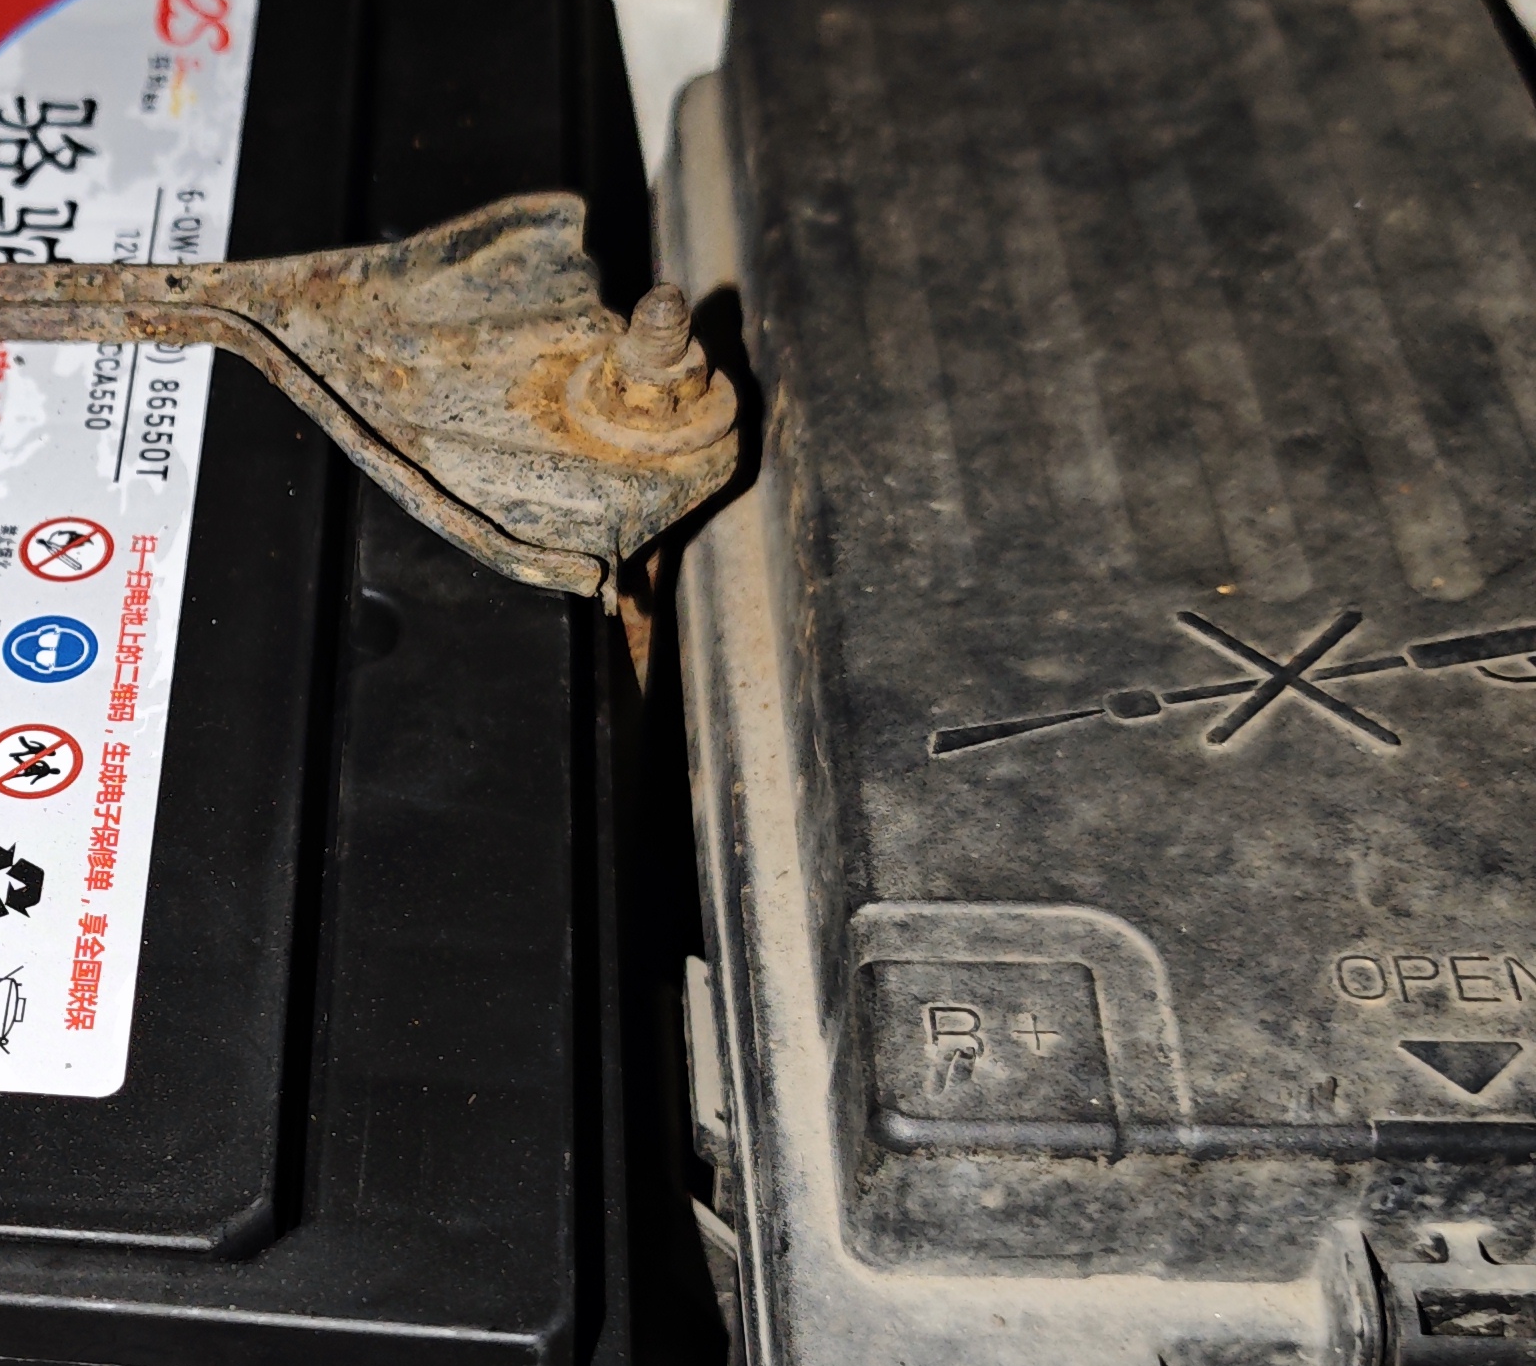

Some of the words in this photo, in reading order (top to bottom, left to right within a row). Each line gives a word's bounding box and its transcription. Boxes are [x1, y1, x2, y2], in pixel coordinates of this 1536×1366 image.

[83, 343, 121, 431] CCA550
[135, 379, 179, 482] 86550T
[1337, 955, 1536, 1003] OPEN
